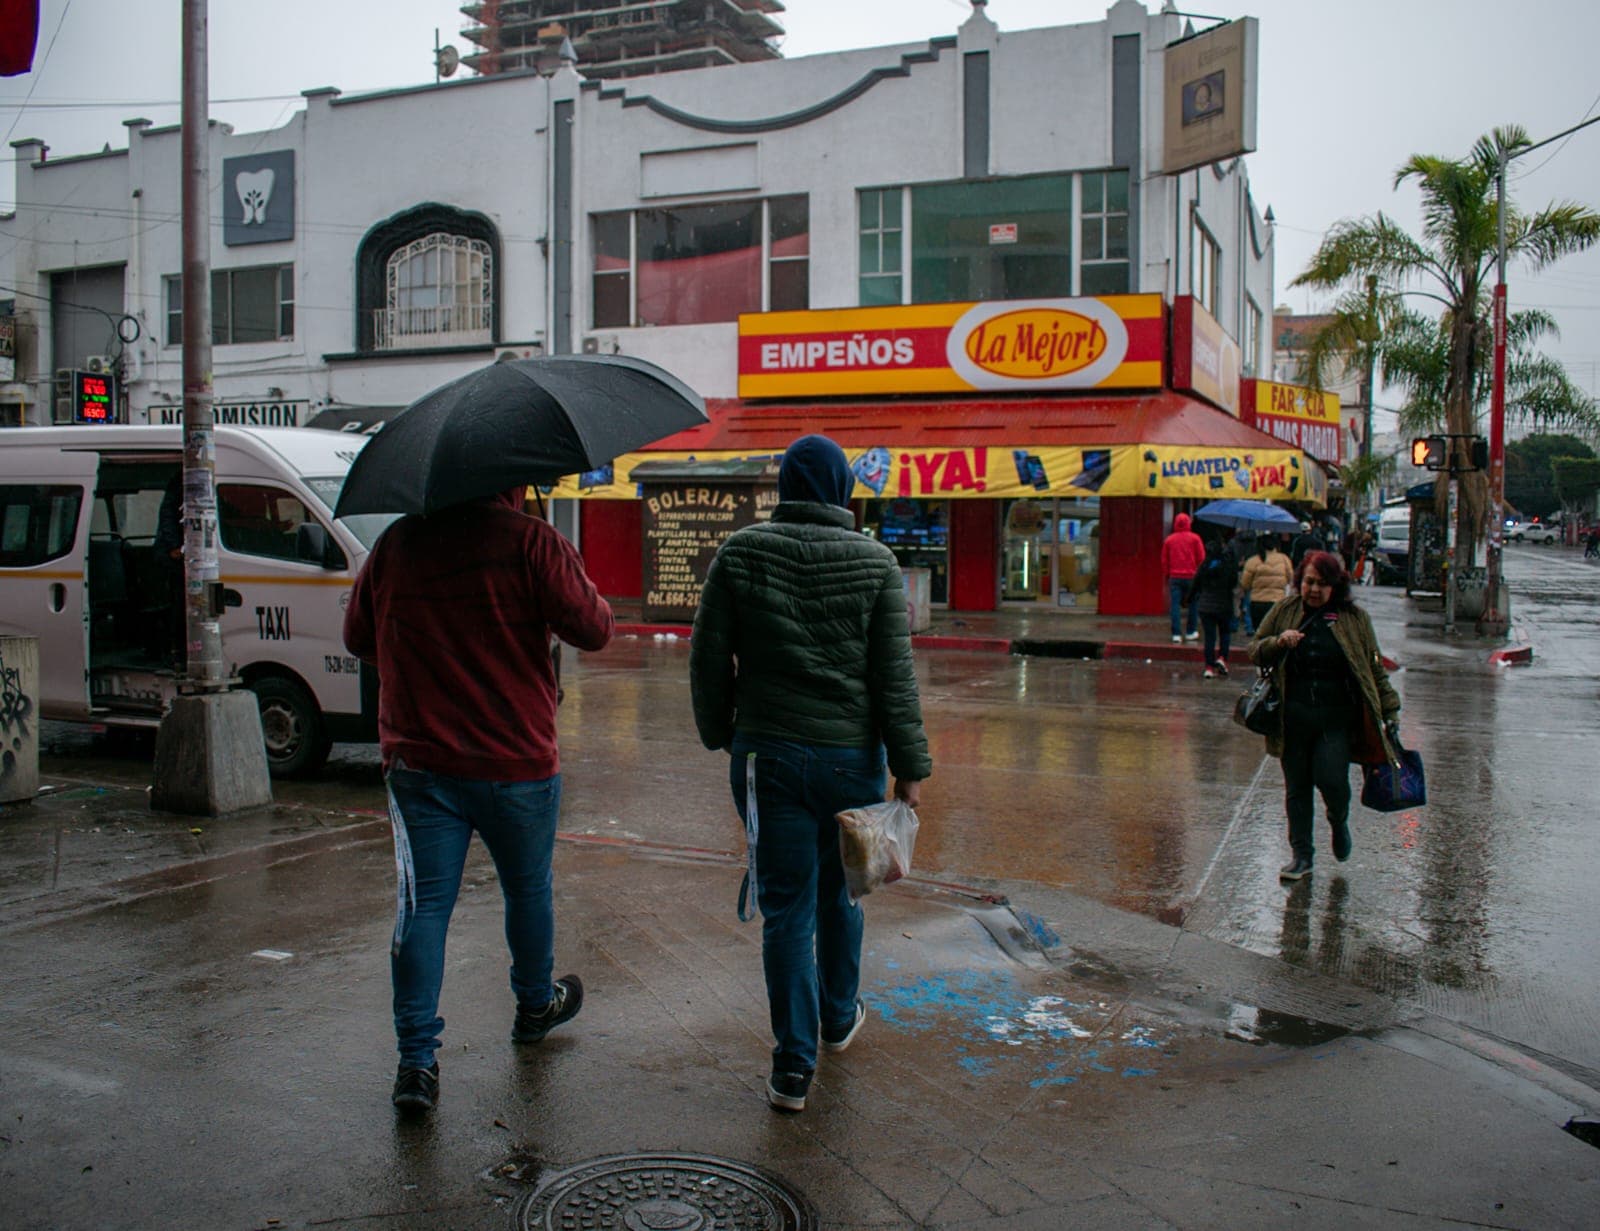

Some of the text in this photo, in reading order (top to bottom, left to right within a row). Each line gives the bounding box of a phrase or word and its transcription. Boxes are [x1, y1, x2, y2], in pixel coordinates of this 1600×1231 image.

[761, 333, 914, 369] EMPEÑOS
[973, 319, 1098, 373] La Mejor!
[898, 447, 987, 498] ¡YA!
[1161, 457, 1286, 494] LLÉVATELO ¡YA!
[255, 606, 290, 641] TAXI
